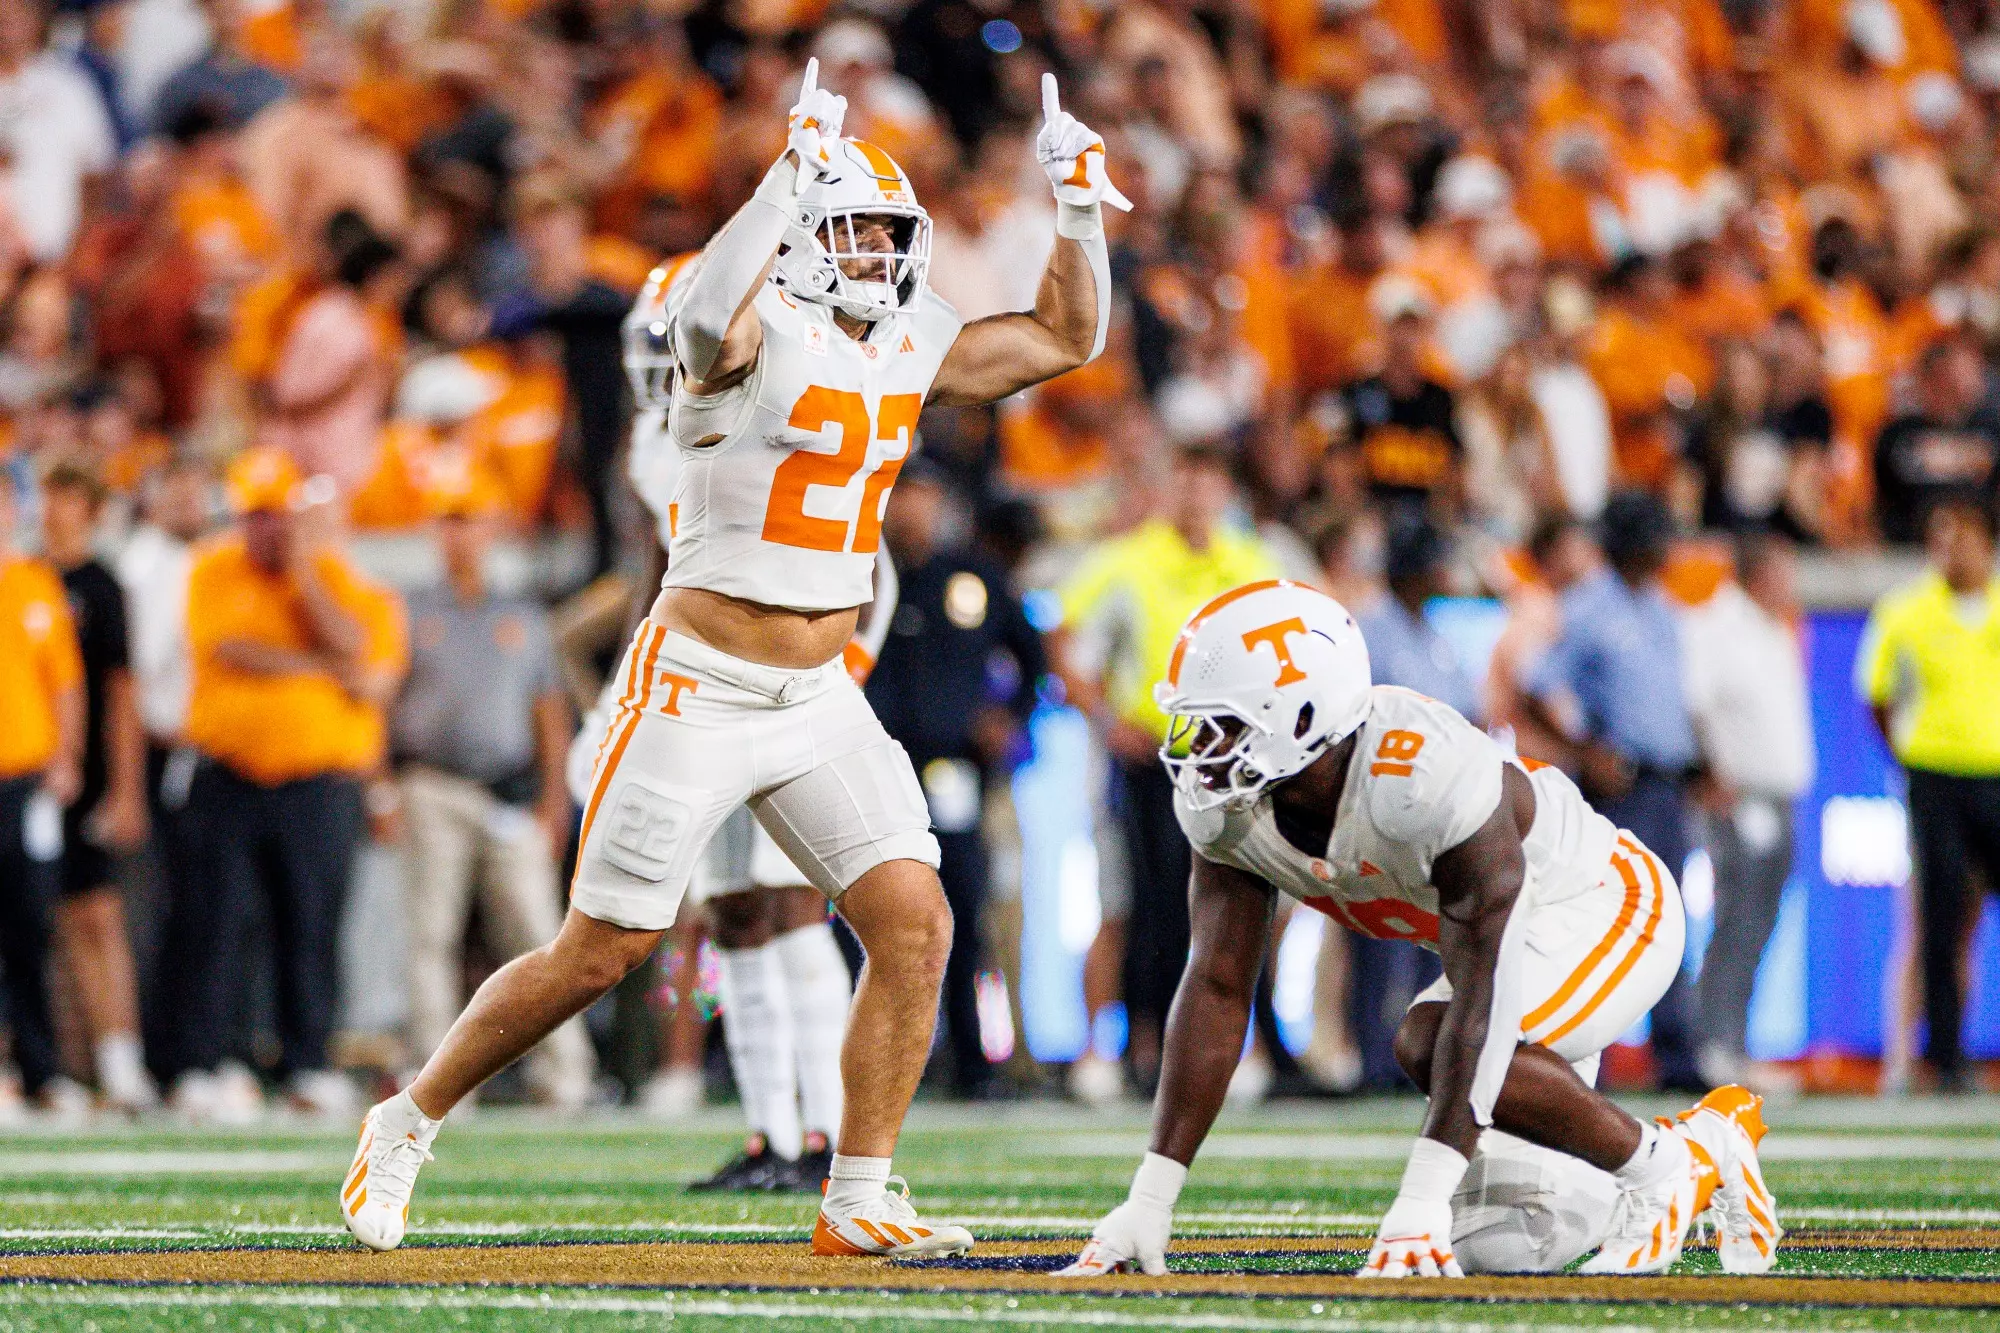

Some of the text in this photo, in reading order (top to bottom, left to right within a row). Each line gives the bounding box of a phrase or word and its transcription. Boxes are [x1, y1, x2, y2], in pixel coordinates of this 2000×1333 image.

[761, 384, 921, 553] 22
[1241, 616, 1308, 688] T
[658, 672, 699, 717] T
[1370, 729, 1425, 777] 18
[608, 801, 679, 864] 22
